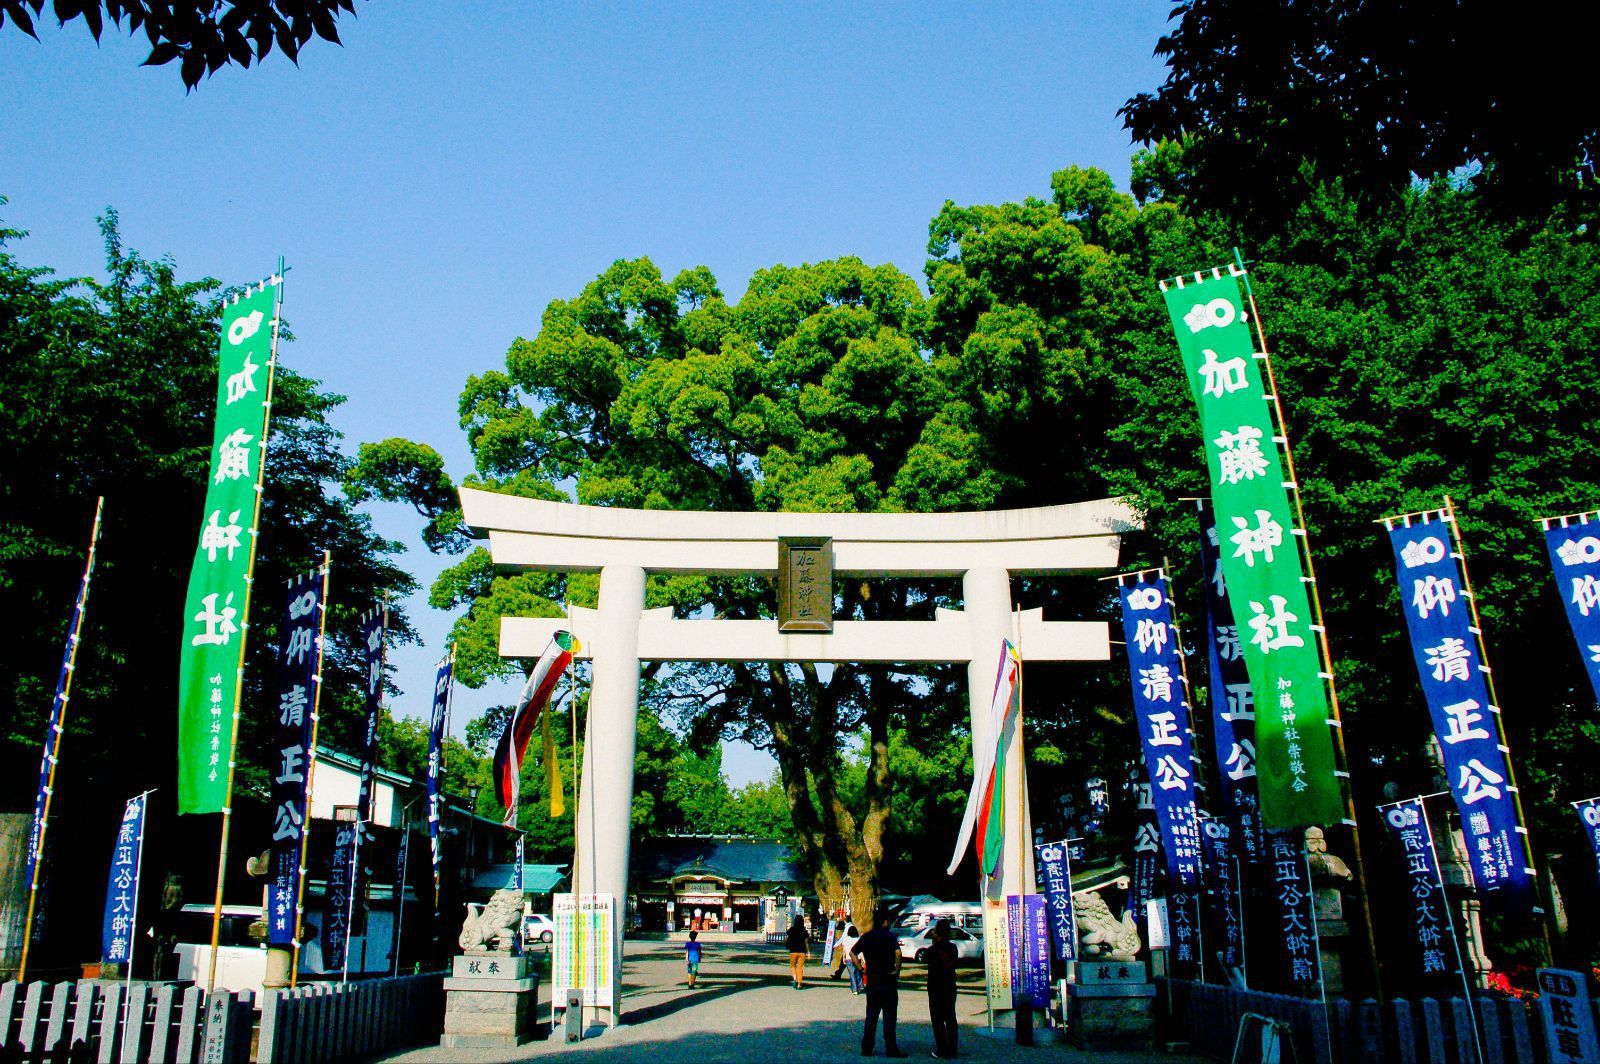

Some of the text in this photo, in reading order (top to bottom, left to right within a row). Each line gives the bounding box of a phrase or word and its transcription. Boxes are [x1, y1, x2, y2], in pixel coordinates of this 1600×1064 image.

[1197, 349, 1304, 654] 加藤神社
[272, 626, 312, 842] 仰清正公
[1133, 619, 1190, 791] 仰清正公
[1277, 677, 1309, 793] 加藤神社崇敬会
[1412, 575, 1504, 805] 仰清正公
